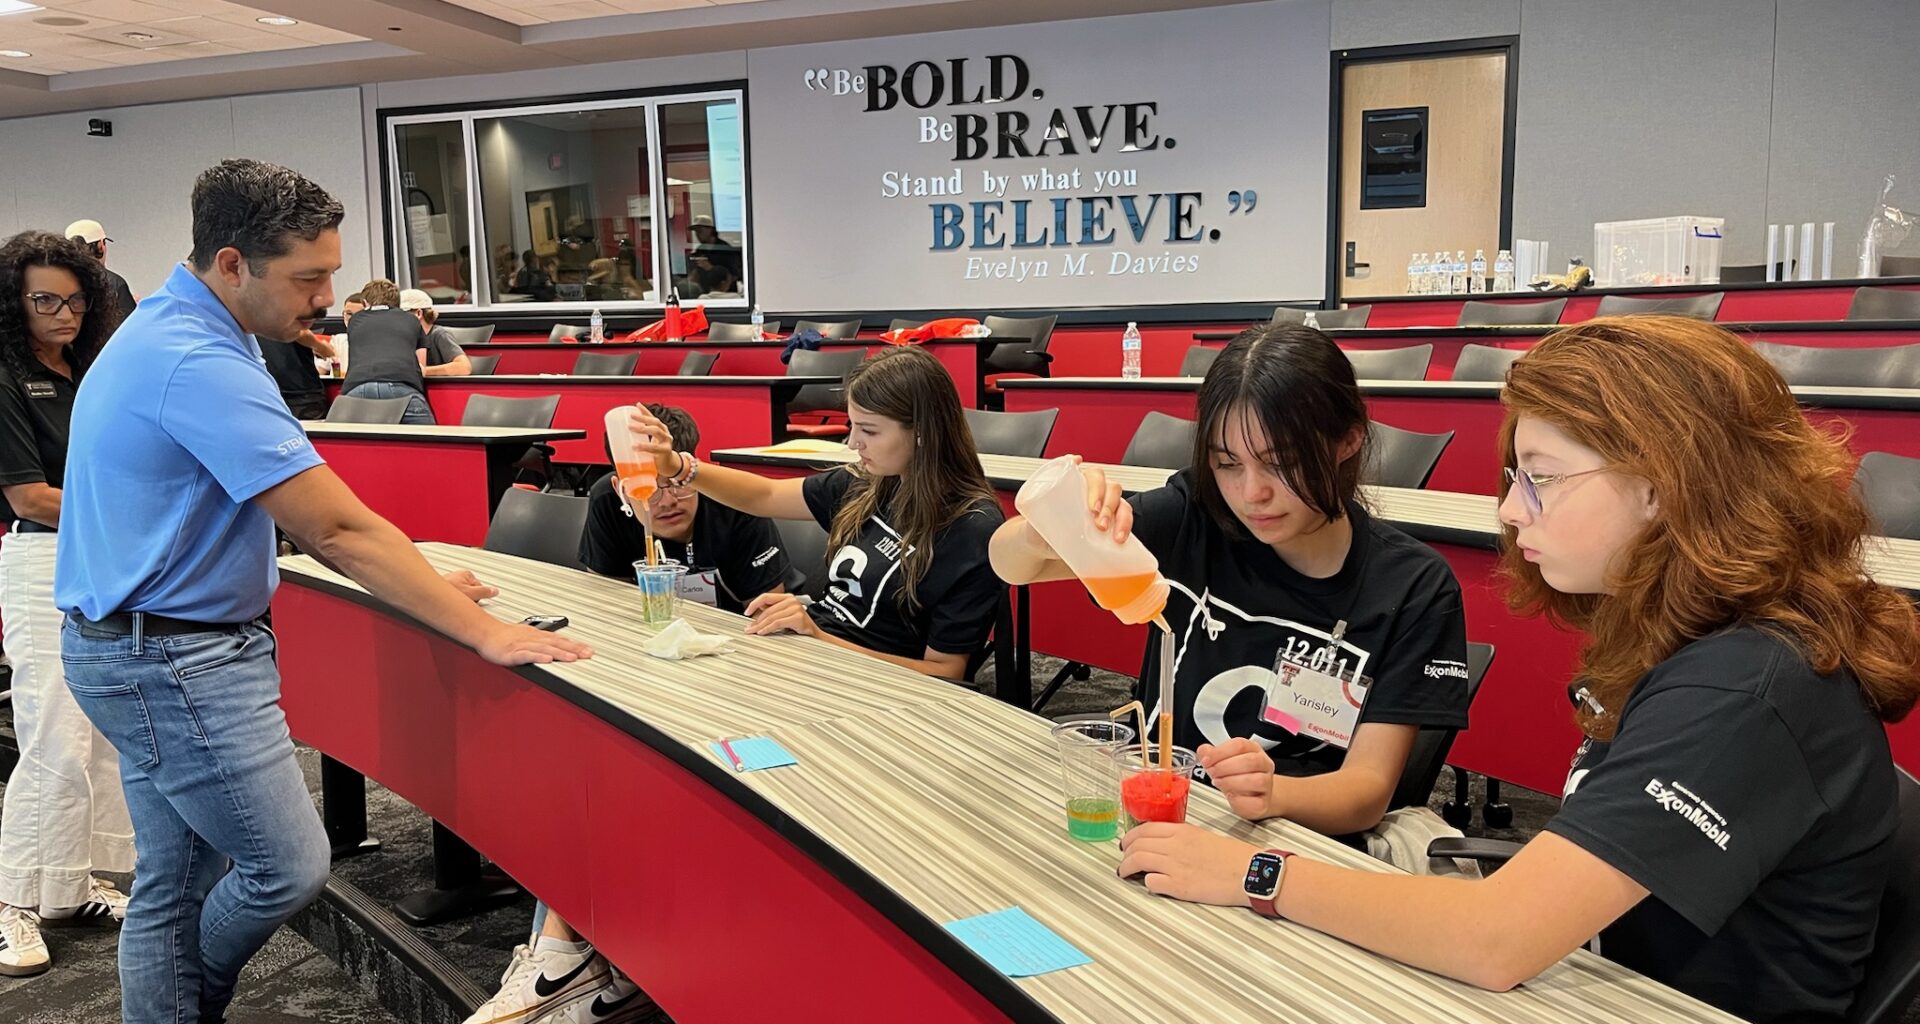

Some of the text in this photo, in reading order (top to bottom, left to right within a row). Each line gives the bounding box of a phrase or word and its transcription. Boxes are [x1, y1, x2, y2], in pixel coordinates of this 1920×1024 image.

[862, 54, 1044, 112] BOLD.
[918, 101, 1176, 161] Be BRAVE.
[881, 168, 1138, 197] Stand by what you
[964, 251, 1200, 283] Evelyn M. Davies
[1281, 636, 1348, 679] 12.011
[1293, 692, 1339, 718] Yarisley
[1307, 723, 1349, 741] ExxonMobil
[1644, 778, 1731, 851] ExxonMobil
